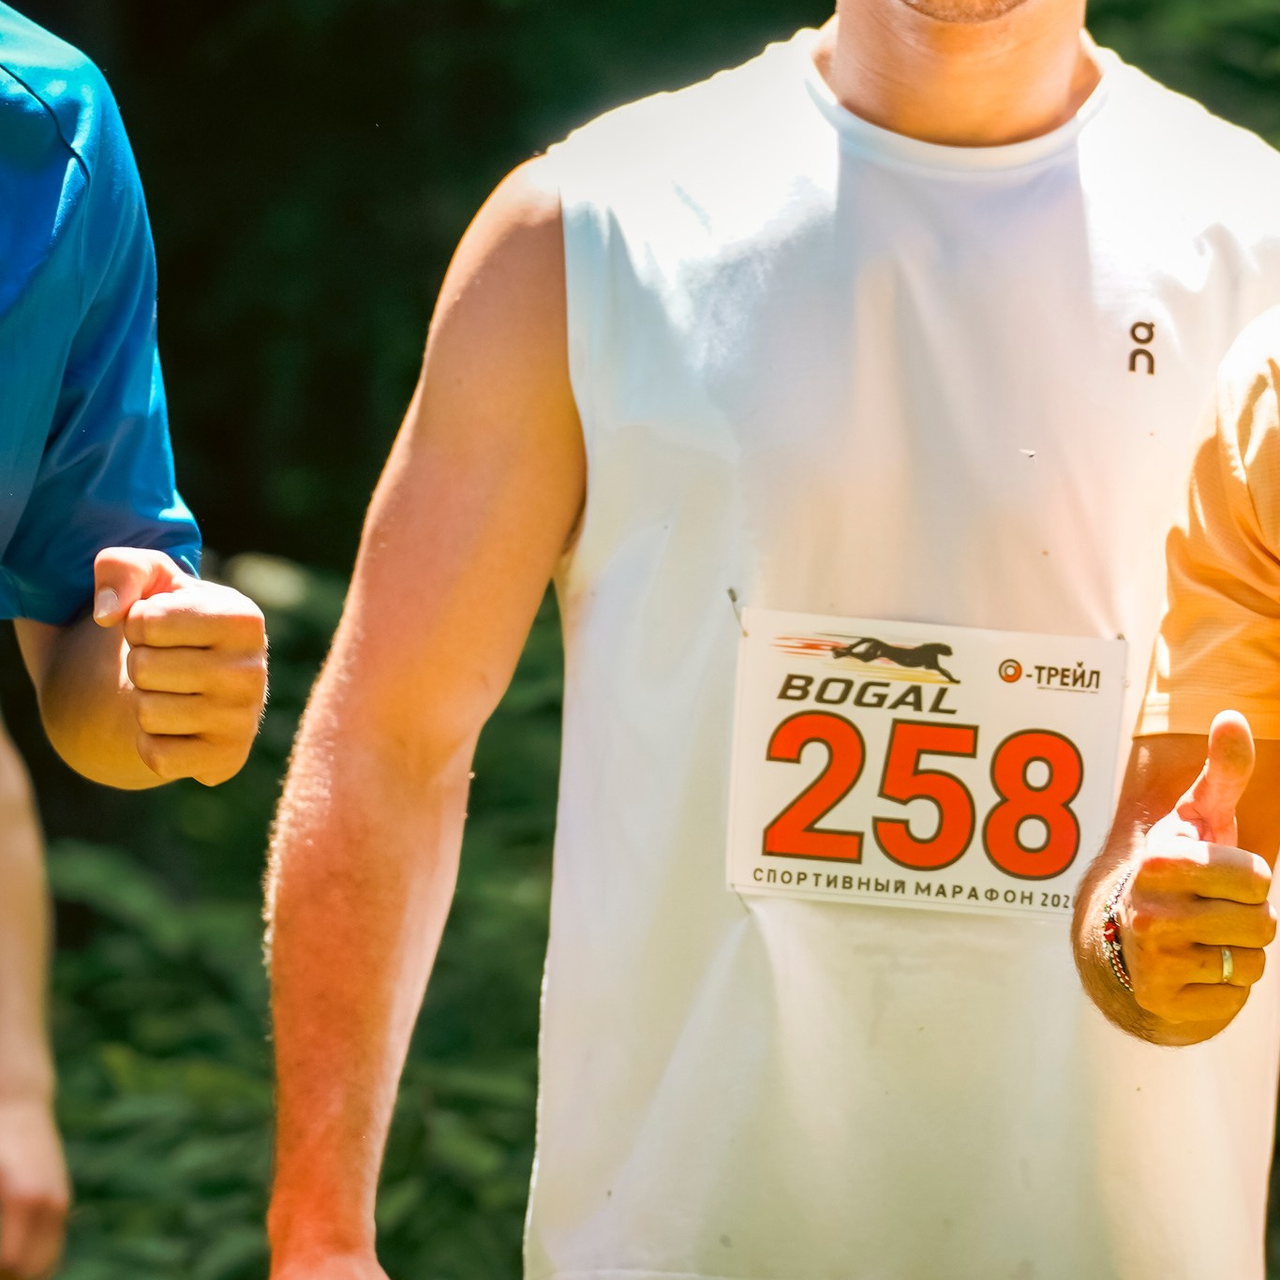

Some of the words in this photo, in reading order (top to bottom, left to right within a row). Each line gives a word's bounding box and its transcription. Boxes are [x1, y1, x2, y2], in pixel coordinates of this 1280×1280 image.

[777, 673, 959, 715] BOGAL
[761, 709, 1084, 881] 258
[753, 867, 906, 895] СПОРТИВНЫЙ
[914, 881, 1034, 906] МАРАФОН
